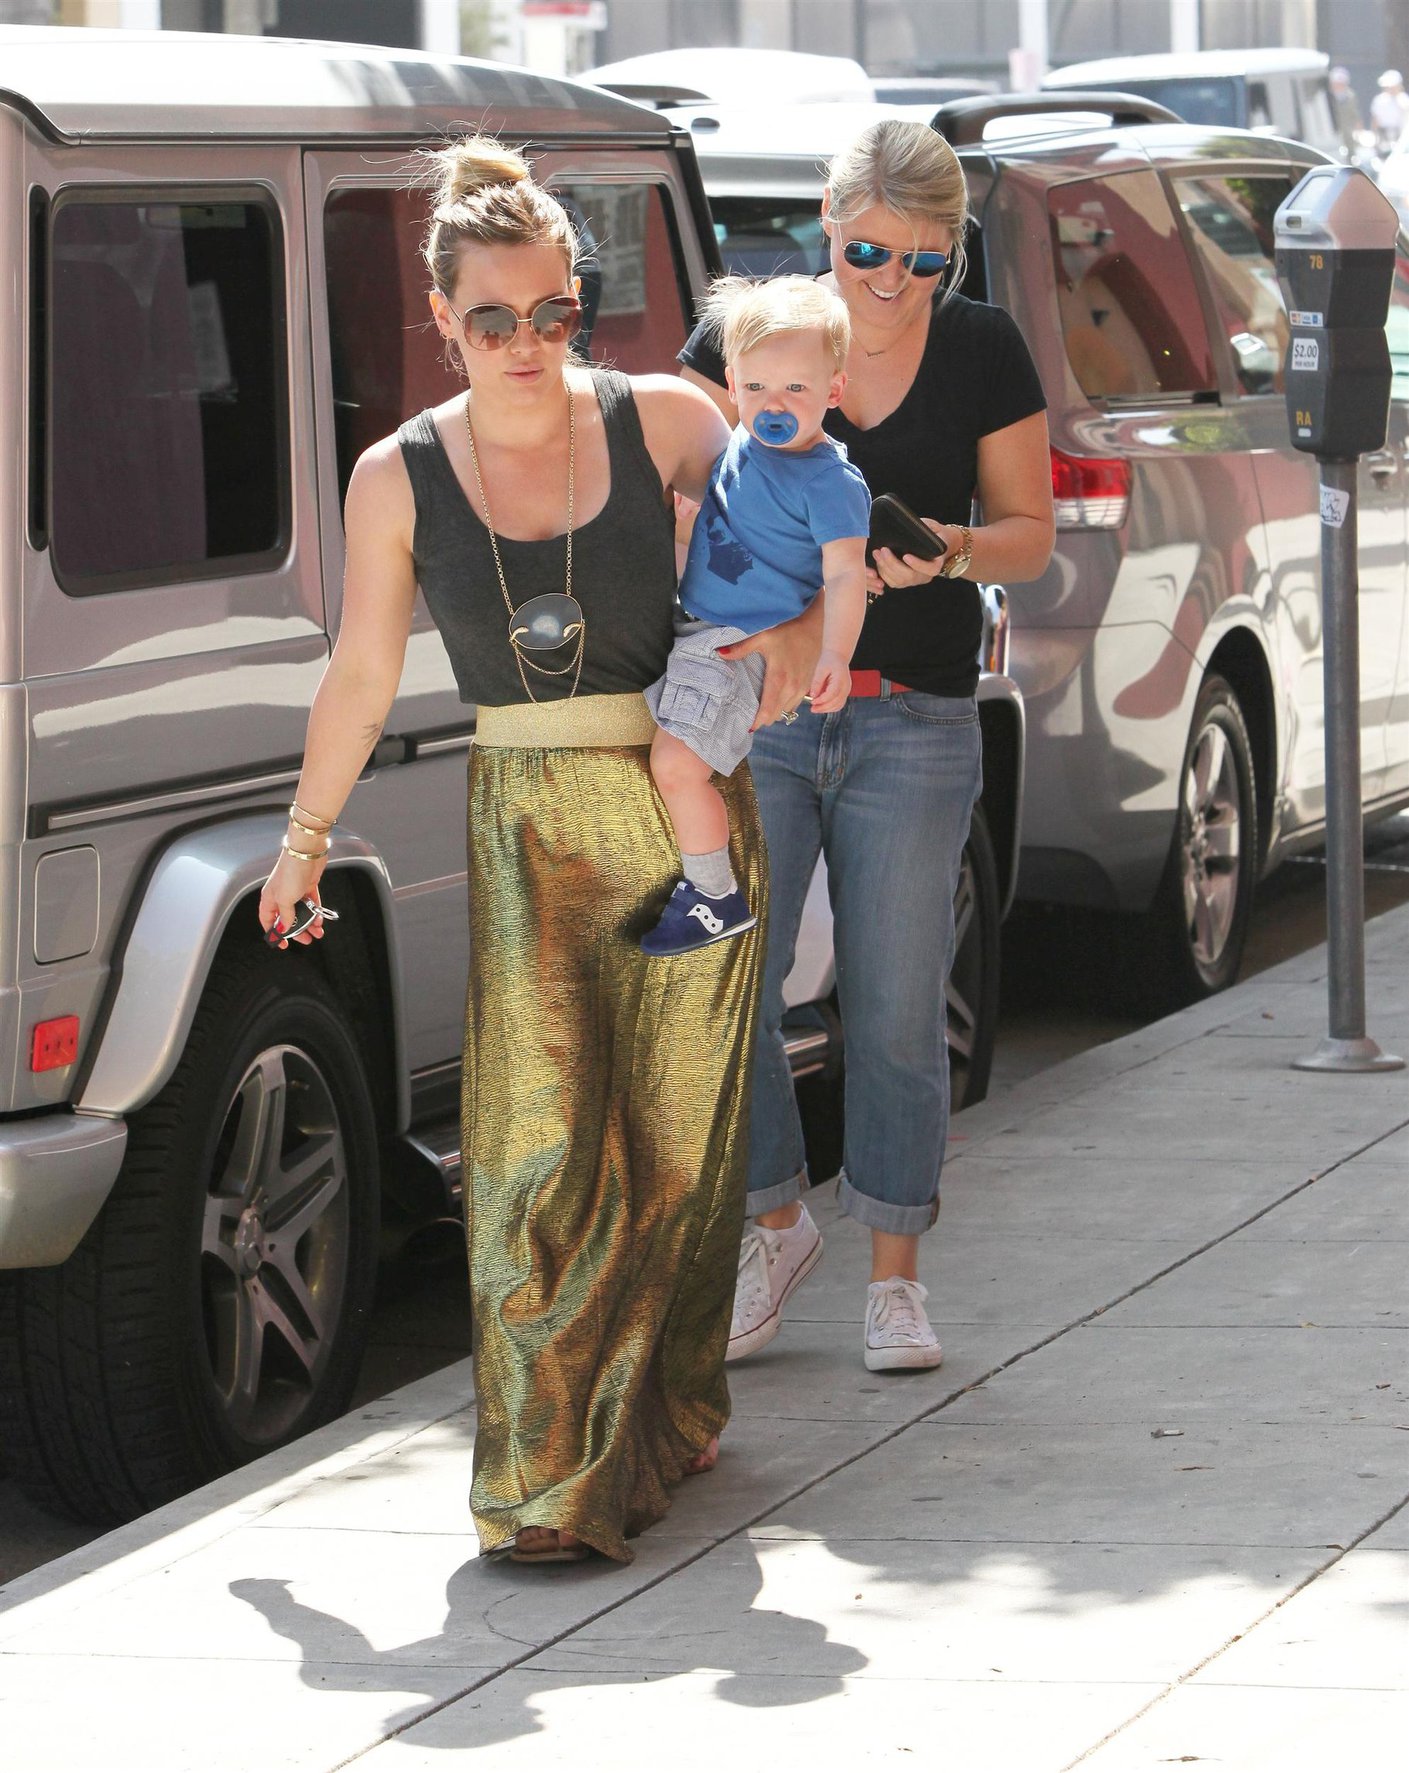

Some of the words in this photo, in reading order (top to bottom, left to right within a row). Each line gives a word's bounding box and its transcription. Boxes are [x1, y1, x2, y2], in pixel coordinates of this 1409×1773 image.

[1309, 255, 1324, 270] 78
[1294, 344, 1318, 358] $2.00
[1296, 411, 1312, 426] RA
